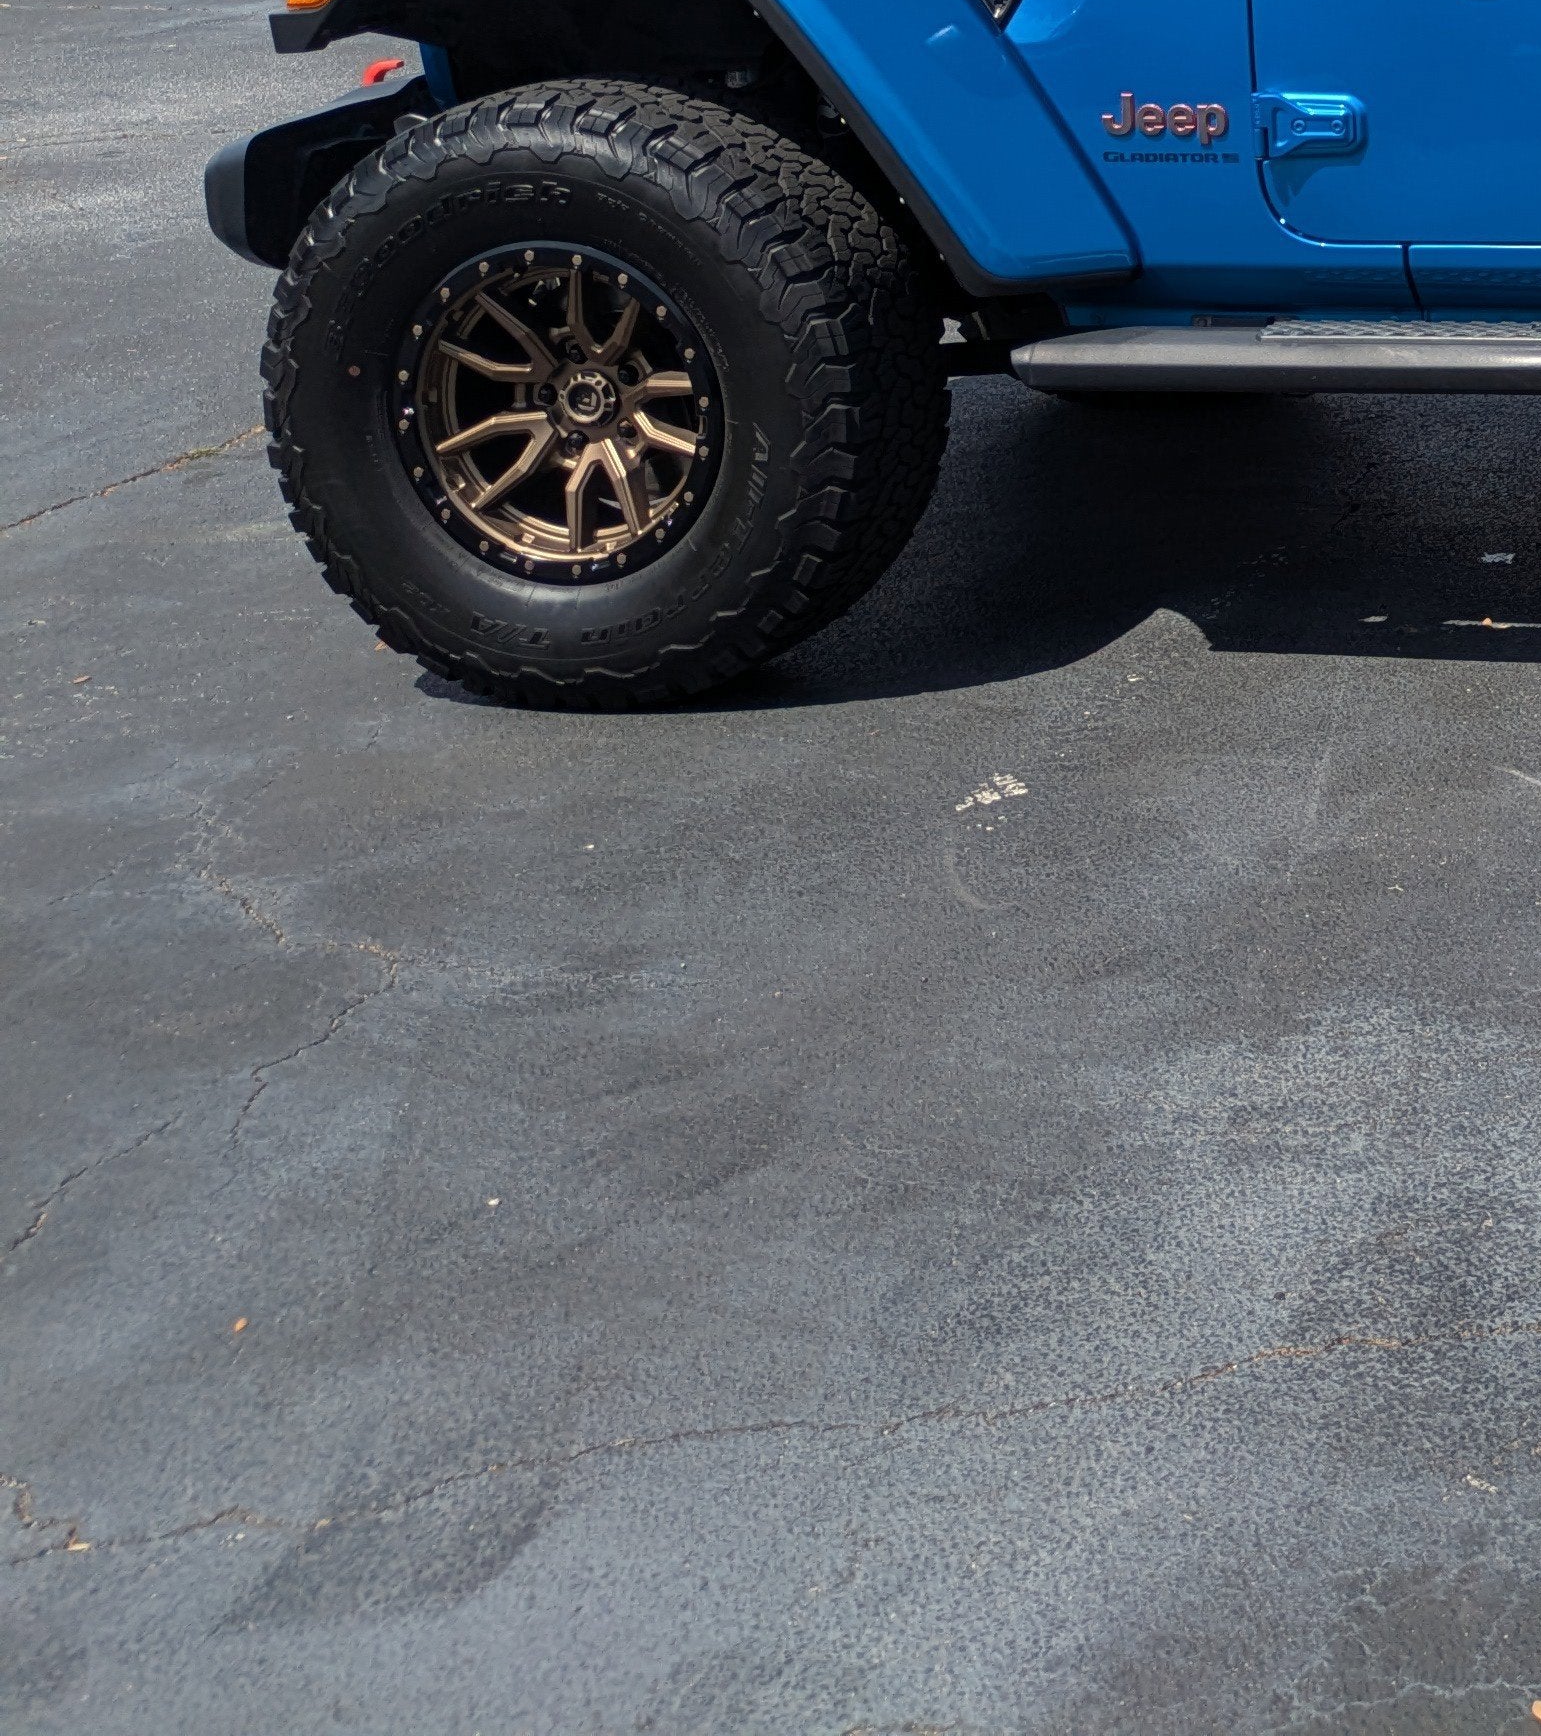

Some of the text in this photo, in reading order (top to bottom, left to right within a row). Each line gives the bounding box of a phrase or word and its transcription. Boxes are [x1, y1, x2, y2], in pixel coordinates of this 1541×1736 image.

[1101, 91, 1229, 145] Jeep
[1103, 151, 1218, 163] GLADIATOR
[469, 610, 552, 651] T/A
